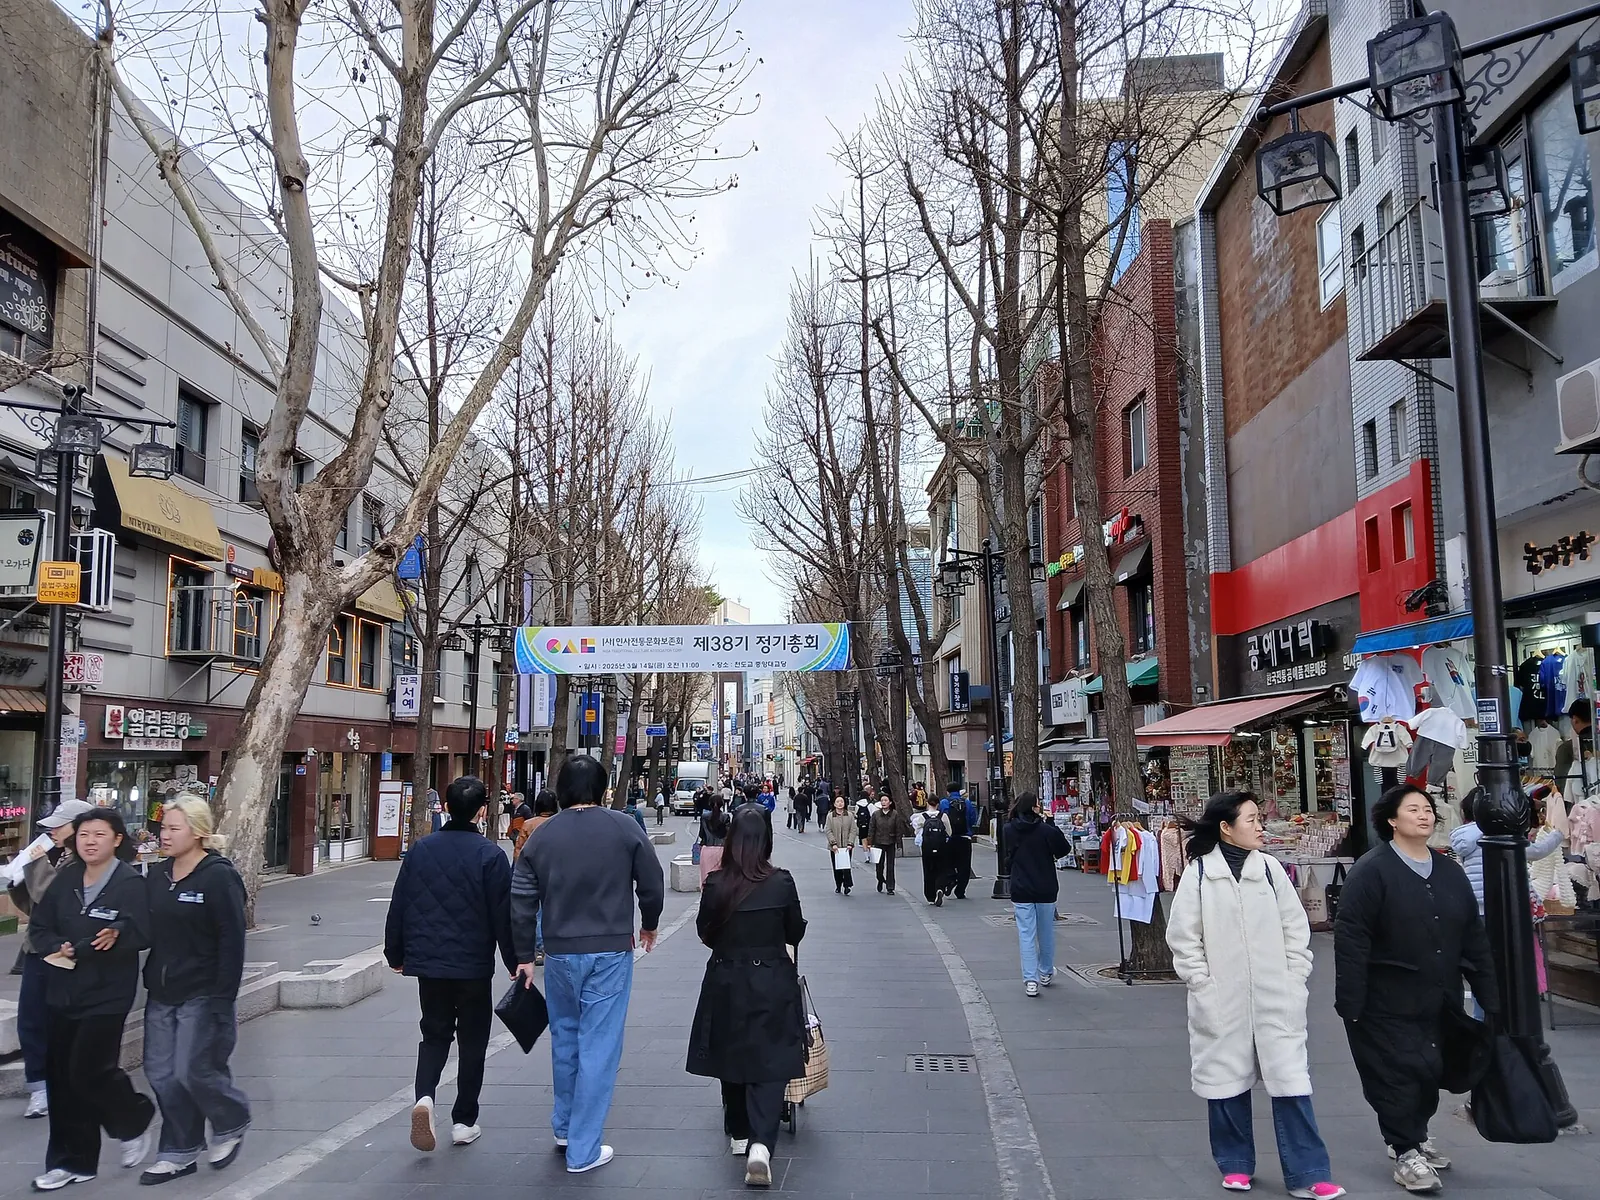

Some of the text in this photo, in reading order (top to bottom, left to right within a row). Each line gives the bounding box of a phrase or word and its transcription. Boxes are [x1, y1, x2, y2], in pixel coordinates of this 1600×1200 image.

[128, 516, 162, 537] NIRVANA
[693, 634, 819, 654] 제38기 정기총회
[602, 662, 625, 670] 2025년
[400, 677, 418, 685] 만곡
[127, 708, 191, 740] 열림필방
